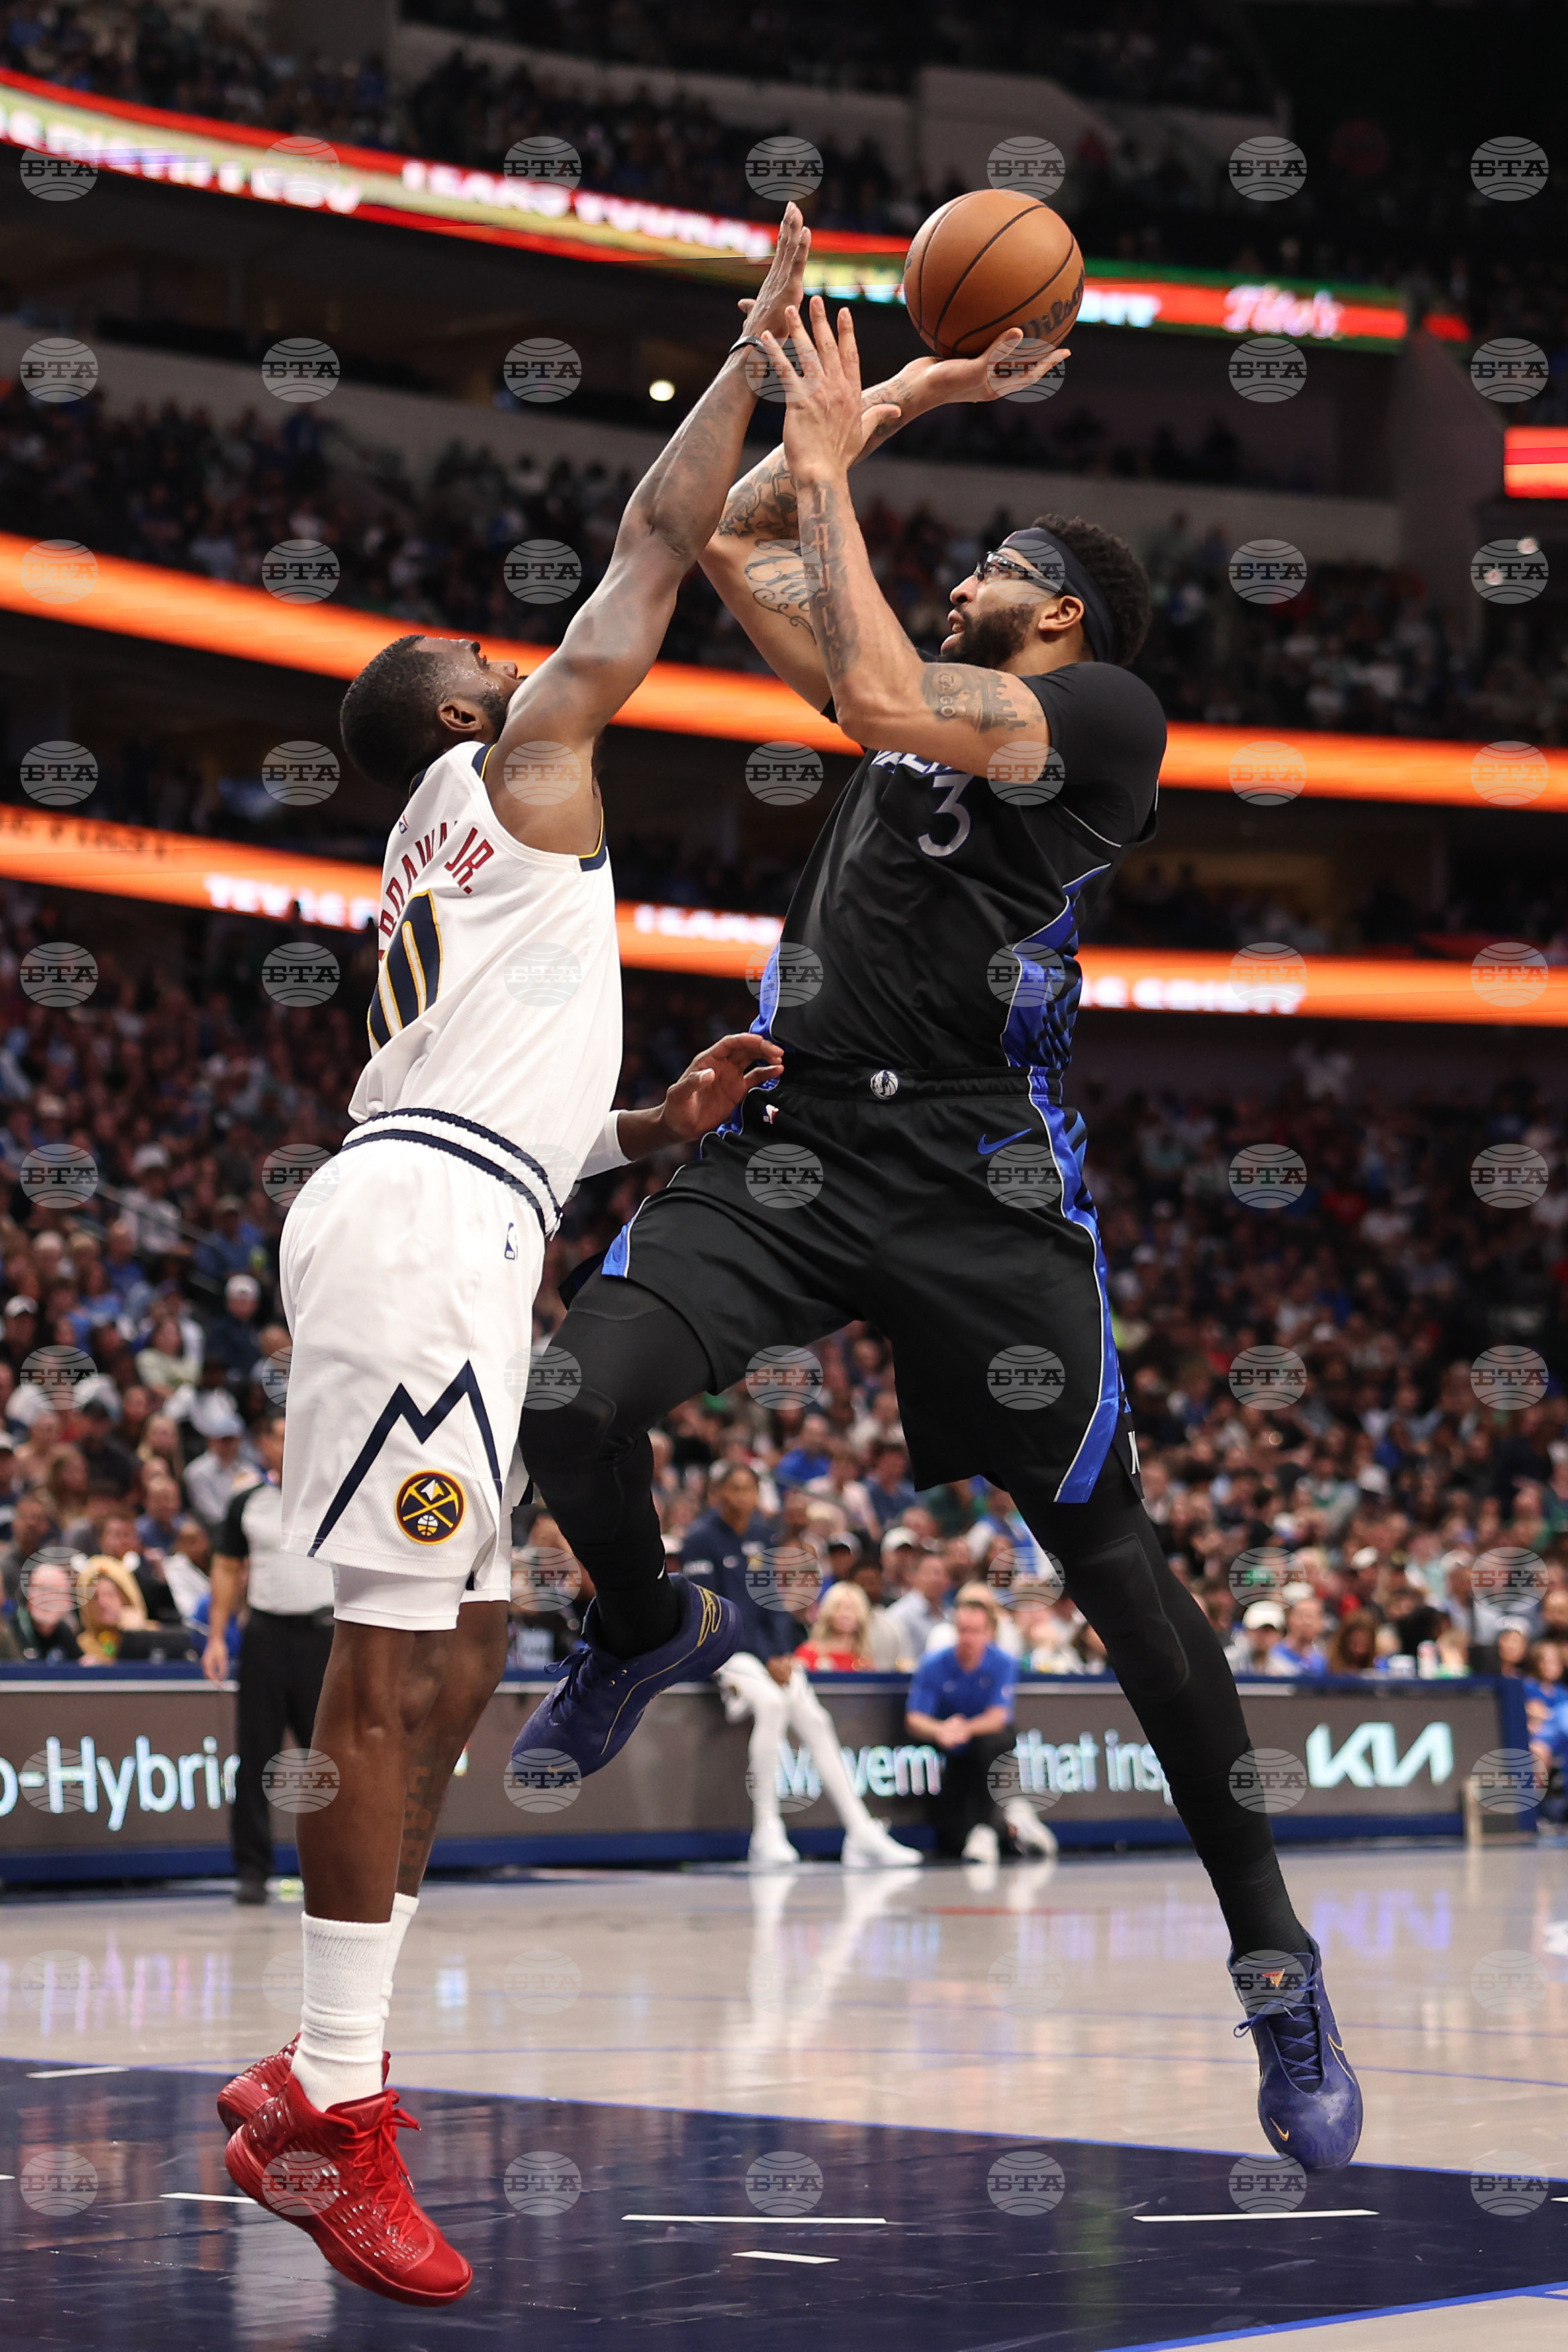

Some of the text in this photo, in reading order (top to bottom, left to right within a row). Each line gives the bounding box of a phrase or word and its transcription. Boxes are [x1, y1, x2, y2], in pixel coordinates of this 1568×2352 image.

[917, 772, 974, 858] 3
[443, 827, 494, 895] JR.
[1012, 1727, 1099, 1793] that
[1305, 1721, 1455, 1789] KIA
